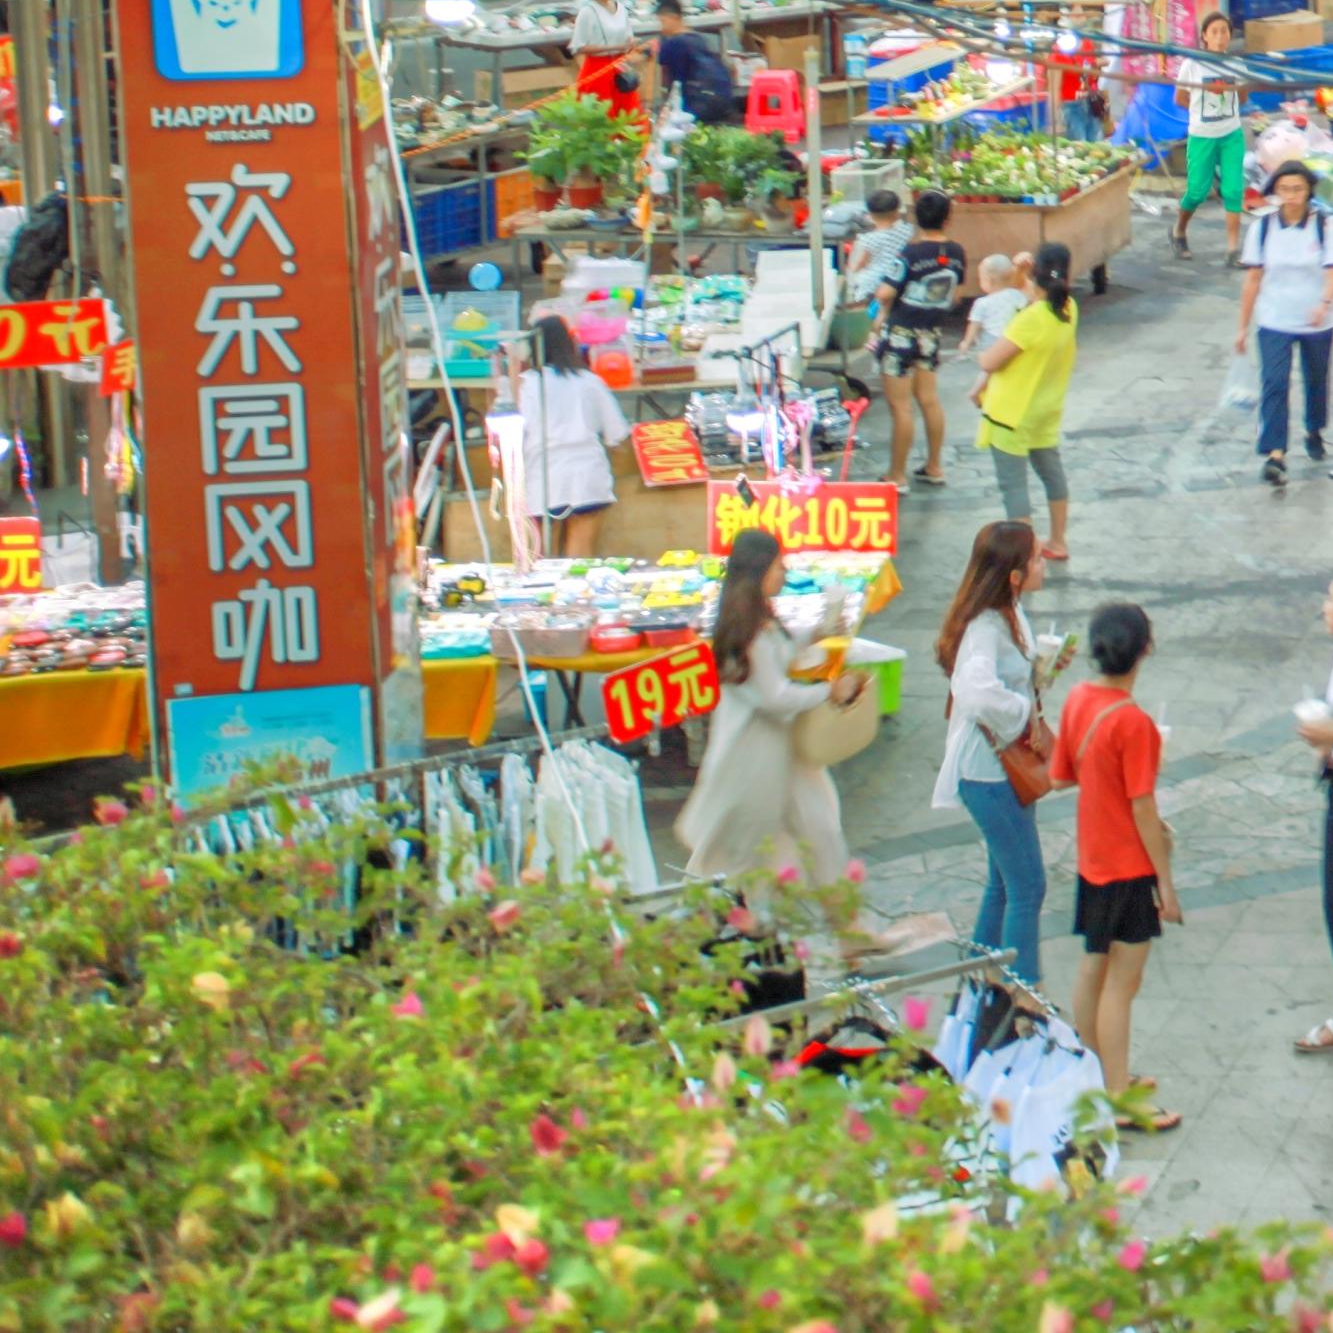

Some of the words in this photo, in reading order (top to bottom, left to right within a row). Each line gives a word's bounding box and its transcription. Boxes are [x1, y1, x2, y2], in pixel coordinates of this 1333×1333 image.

[150, 102, 315, 128] HAPPYLAND
[185, 162, 321, 692] 欢乐园网咖
[610, 648, 715, 730] 19元
